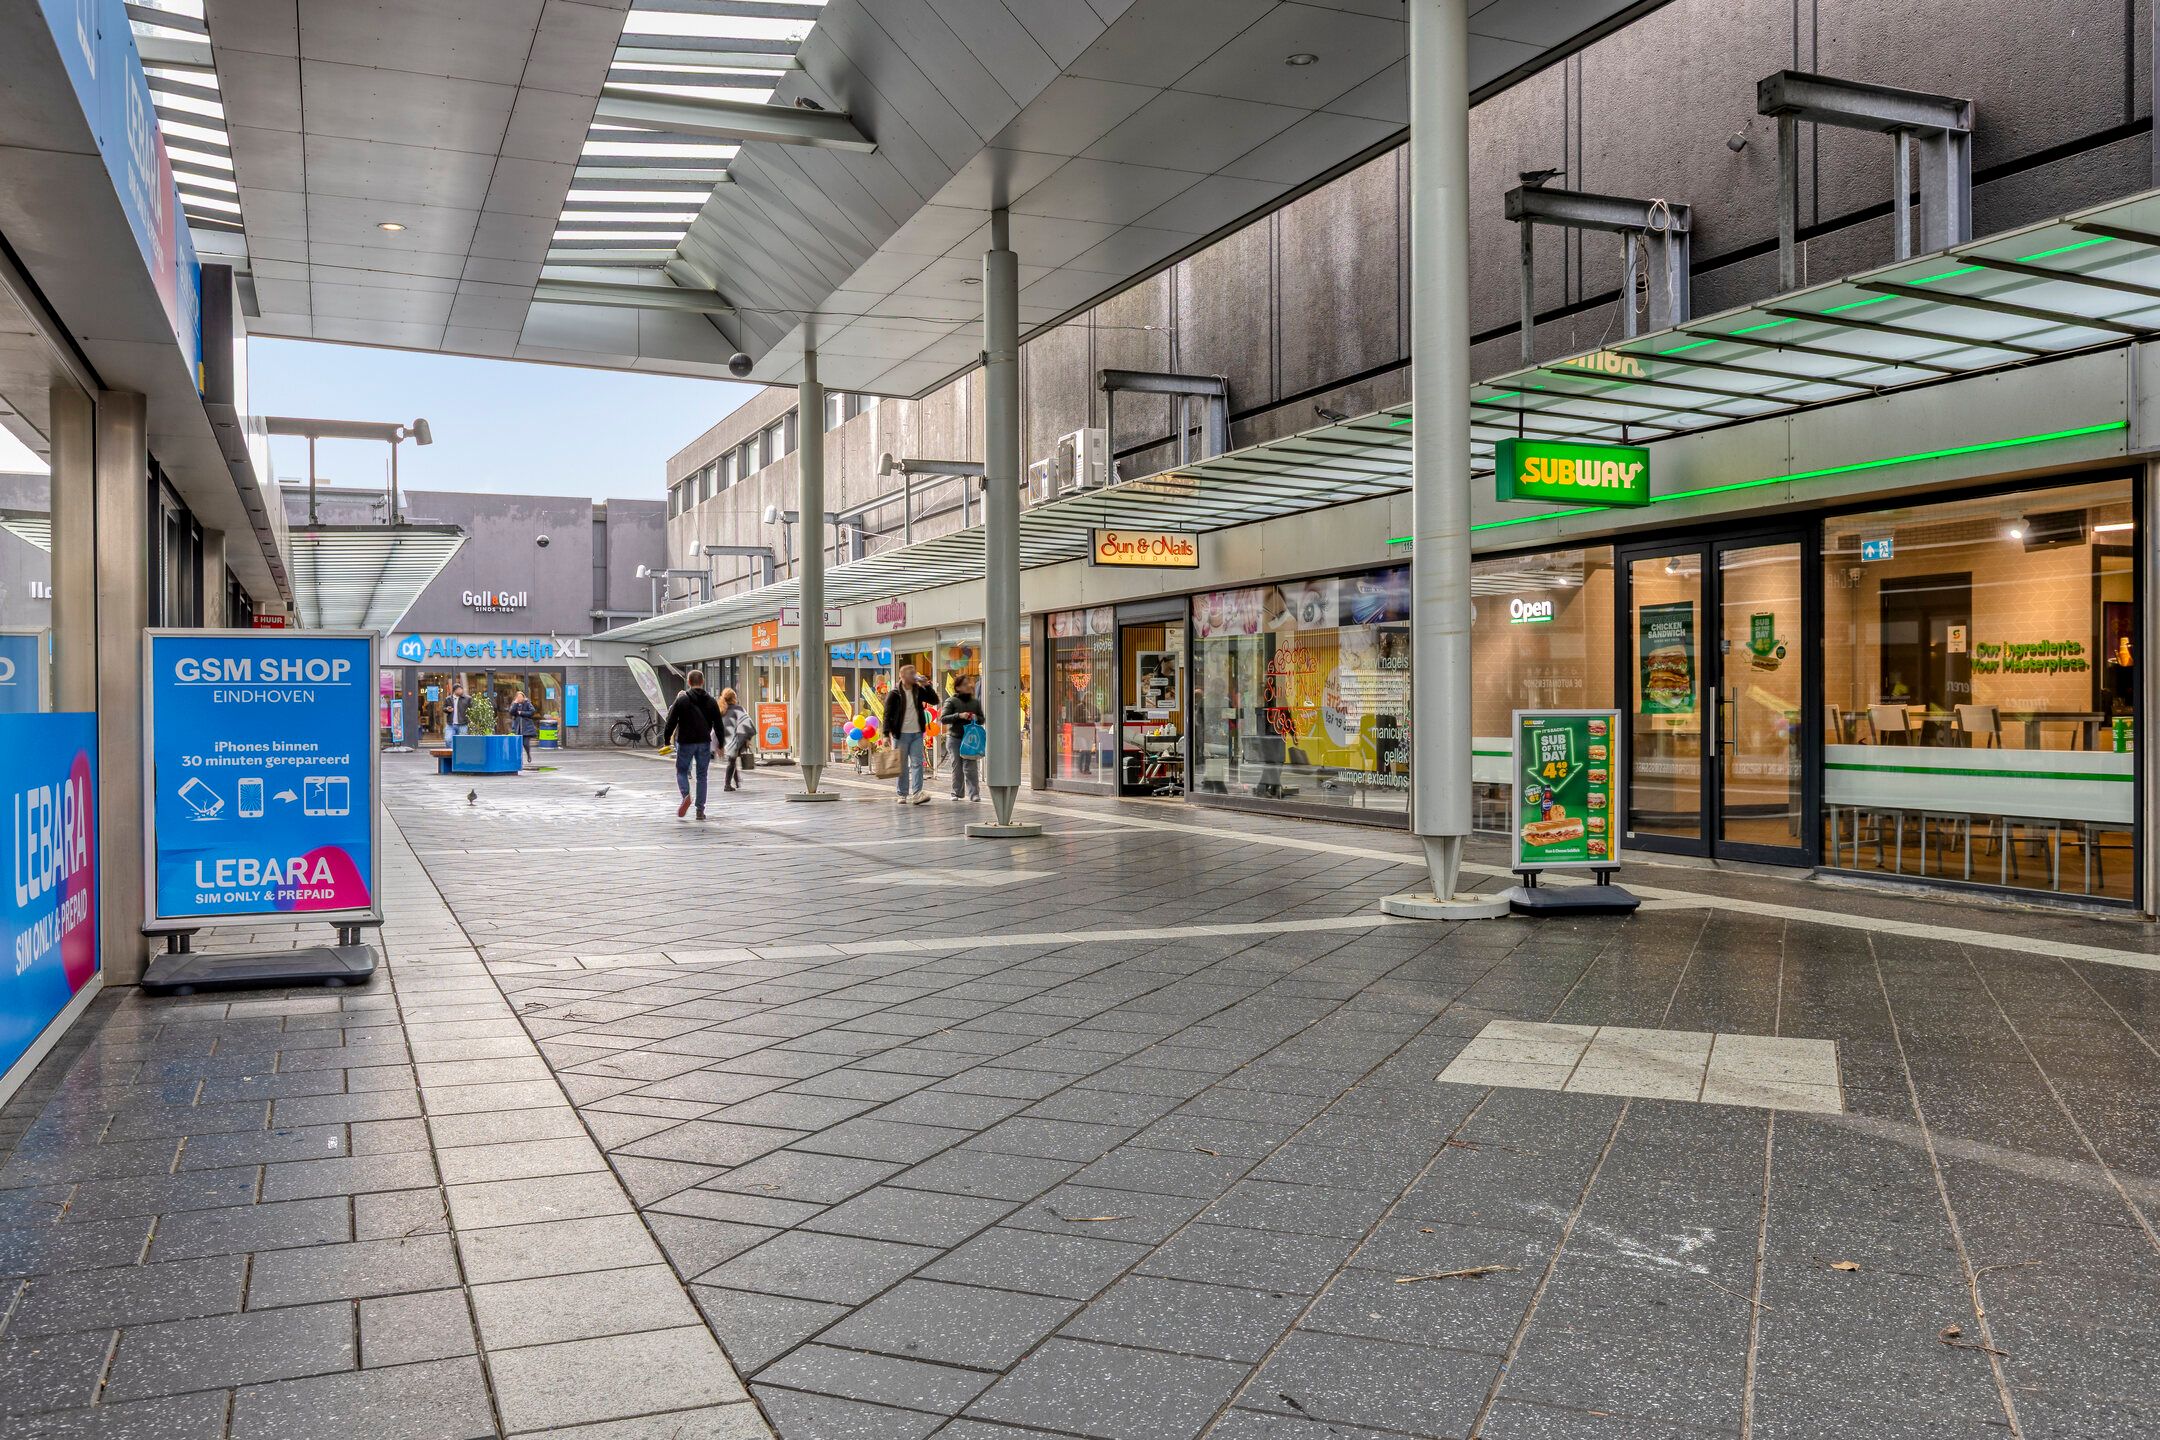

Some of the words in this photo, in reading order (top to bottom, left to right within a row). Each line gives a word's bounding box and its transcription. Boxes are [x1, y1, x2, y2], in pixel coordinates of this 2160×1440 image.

[1520, 457, 1644, 489] SUBWAY
[1101, 532, 1134, 556] Sun
[1137, 537, 1150, 554] &
[1152, 535, 1194, 556] Nails
[1117, 555, 1181, 563] STUDIO
[1510, 598, 1552, 623] Open
[260, 616, 283, 624] HUUR
[1651, 621, 1683, 632] CHICKEN
[1755, 618, 1770, 626] SUB
[1648, 628, 1686, 639] SANDWICH
[1755, 631, 1769, 639] DAY
[429, 638, 496, 658] Albert
[501, 639, 553, 663] Heijn
[554, 638, 589, 659] XL
[1976, 641, 2001, 658] Our
[175, 657, 251, 682] GSM
[259, 657, 351, 682] SHOP
[1382, 653, 1409, 673] nagels
[1971, 658, 2000, 674] Your
[213, 690, 315, 703] EINDHOVEN
[1371, 724, 1409, 740] manicure
[1540, 734, 1566, 746] SUB
[214, 741, 269, 752] iPhones
[273, 741, 318, 751] binnen
[182, 755, 202, 767] 30
[205, 754, 262, 767] minuten
[265, 754, 350, 768] gerepareerd
[1384, 748, 1408, 766] gellak
[1542, 751, 1566, 762] DAY
[1543, 762, 1557, 779] 4
[1556, 761, 1568, 769] 49
[1338, 769, 1366, 787] wimper
[1367, 771, 1408, 788] extentions
[15, 776, 87, 908] LEBARA
[195, 856, 335, 889] LEBARA
[195, 893, 221, 904] SIM
[223, 891, 261, 902] ONLY
[264, 890, 275, 901] &
[278, 889, 335, 900] PREPAID
[16, 928, 33, 976] SIM
[33, 912, 54, 961] ONLY
[54, 907, 62, 943] &
[61, 888, 88, 938] PREPAID
